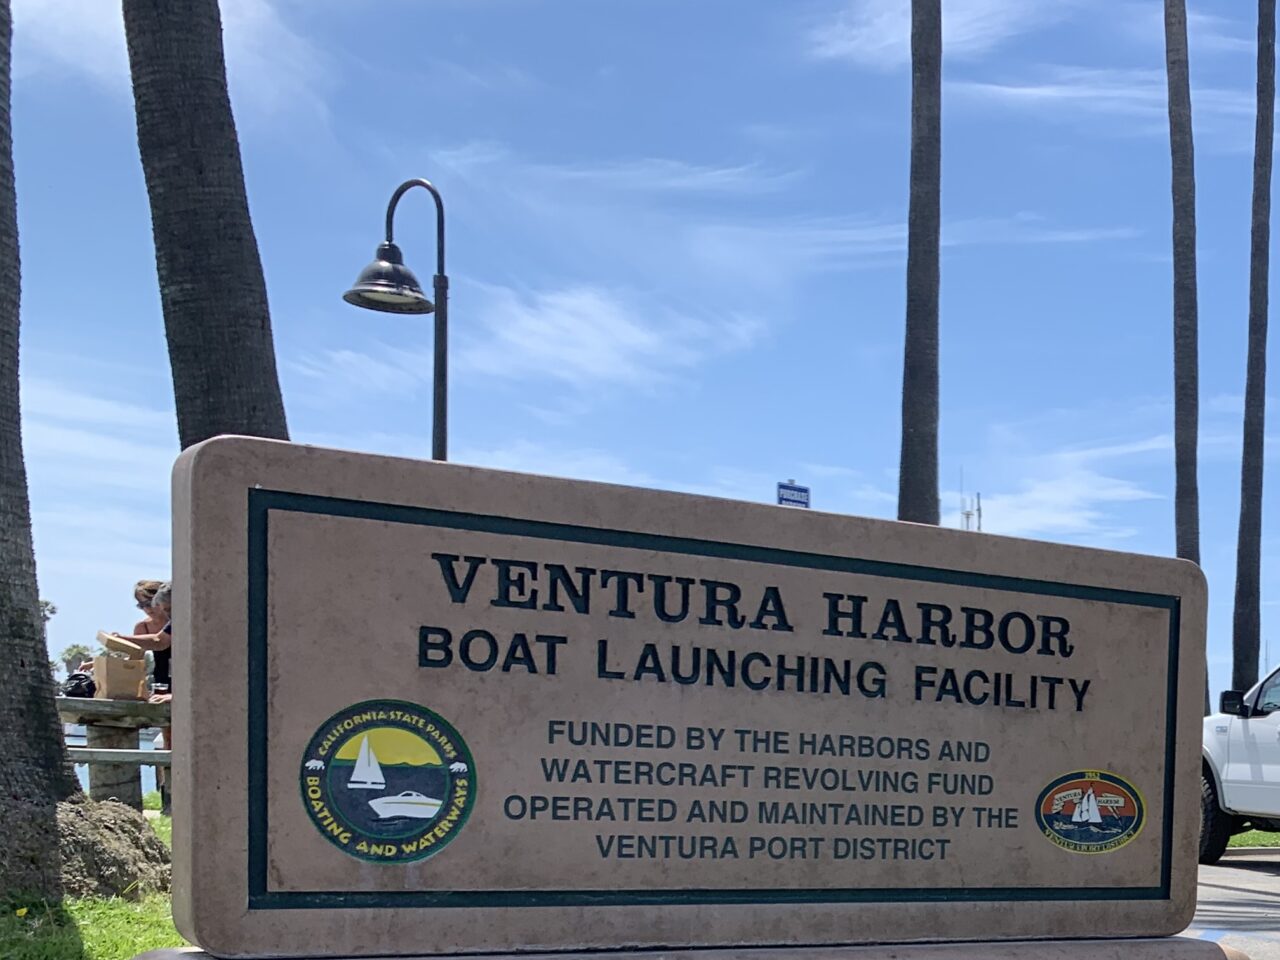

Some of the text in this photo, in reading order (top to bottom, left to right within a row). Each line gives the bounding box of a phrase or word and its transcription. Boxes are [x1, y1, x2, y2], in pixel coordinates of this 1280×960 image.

[431, 552, 1074, 658] VENTURA HARBOR
[418, 625, 1091, 711] BOAT LAUNCHING FACILITY
[318, 710, 459, 759] CALIFORNIA STATE PARKS
[548, 720, 990, 762] FUNDED BY THE HARBORS AND
[541, 758, 994, 795] WATERCRAFT REVOLVING FUND
[306, 776, 468, 856] BOATING AND WATERWAYS
[503, 795, 1019, 828] OPERATED AND MAINTAINED BY THE
[596, 835, 951, 860] VENTURA PORT DISTRICT
